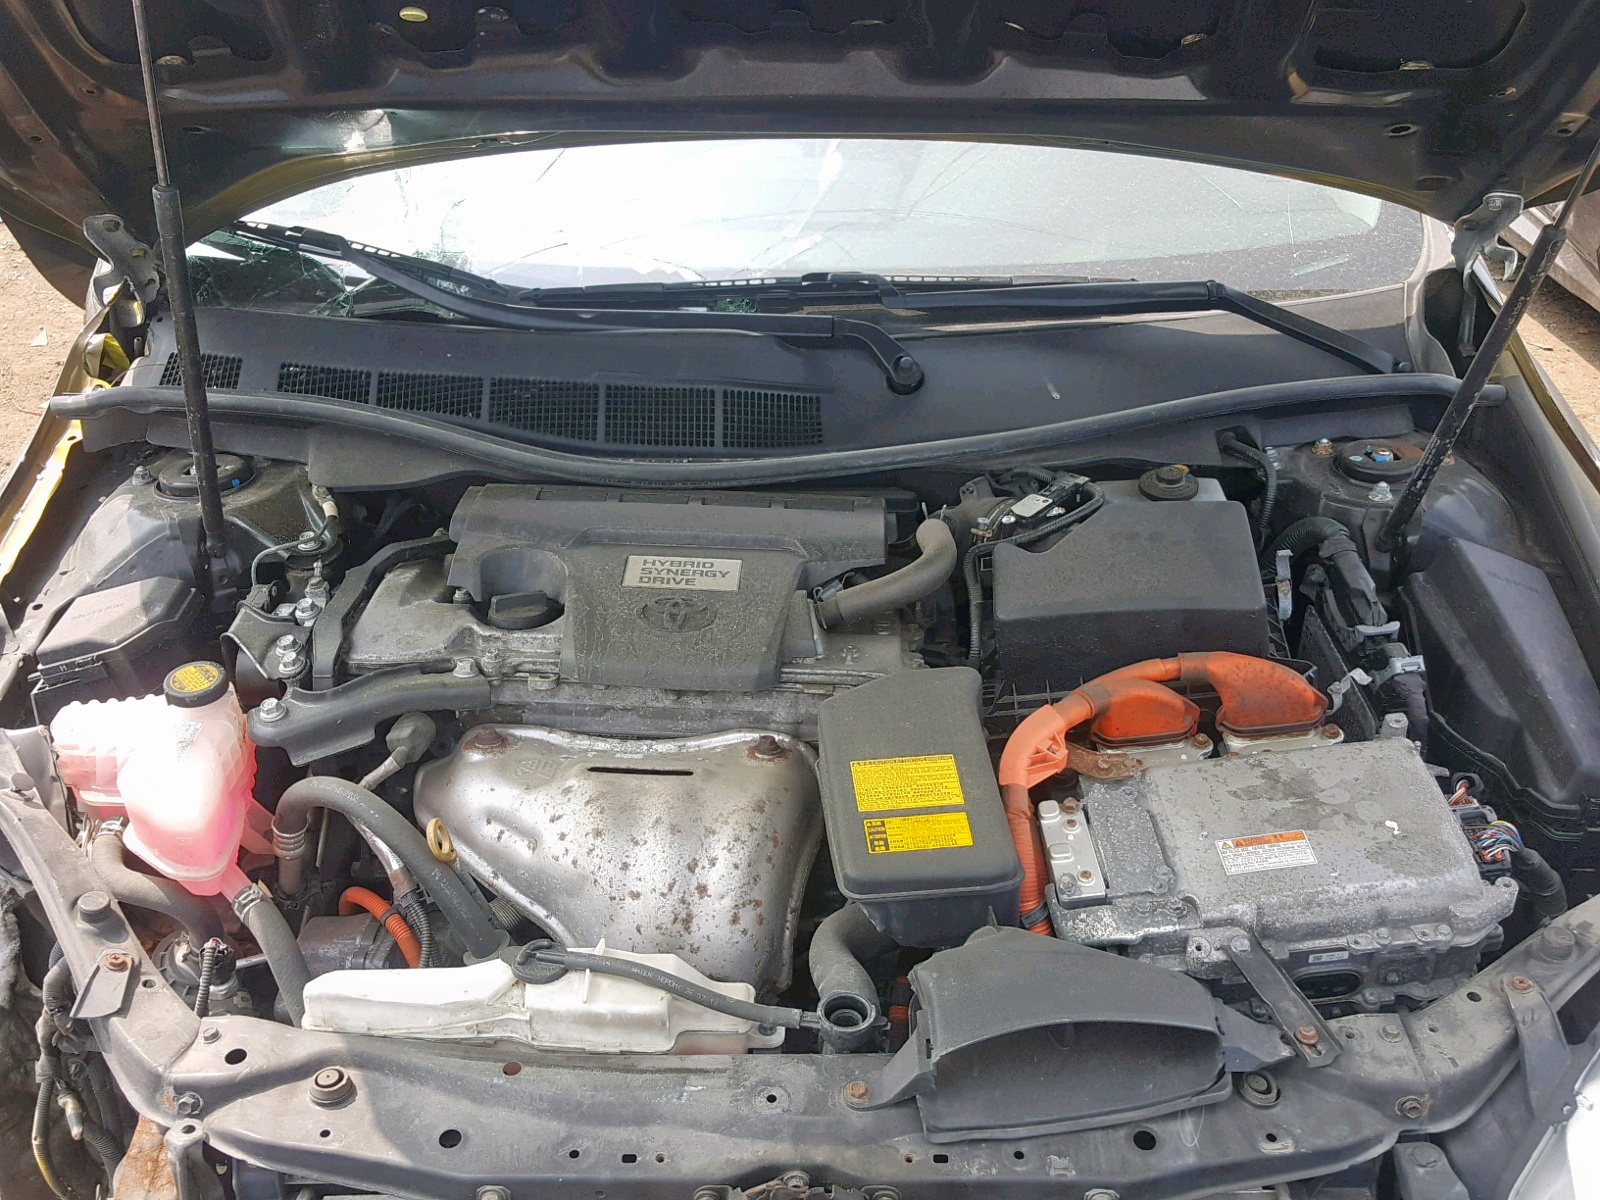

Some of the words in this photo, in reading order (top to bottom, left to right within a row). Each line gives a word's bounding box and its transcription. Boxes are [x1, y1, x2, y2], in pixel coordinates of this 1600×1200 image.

[642, 559, 714, 569] HYBRID
[640, 567, 731, 579] SYNERGY
[638, 576, 696, 586] DRIVE
